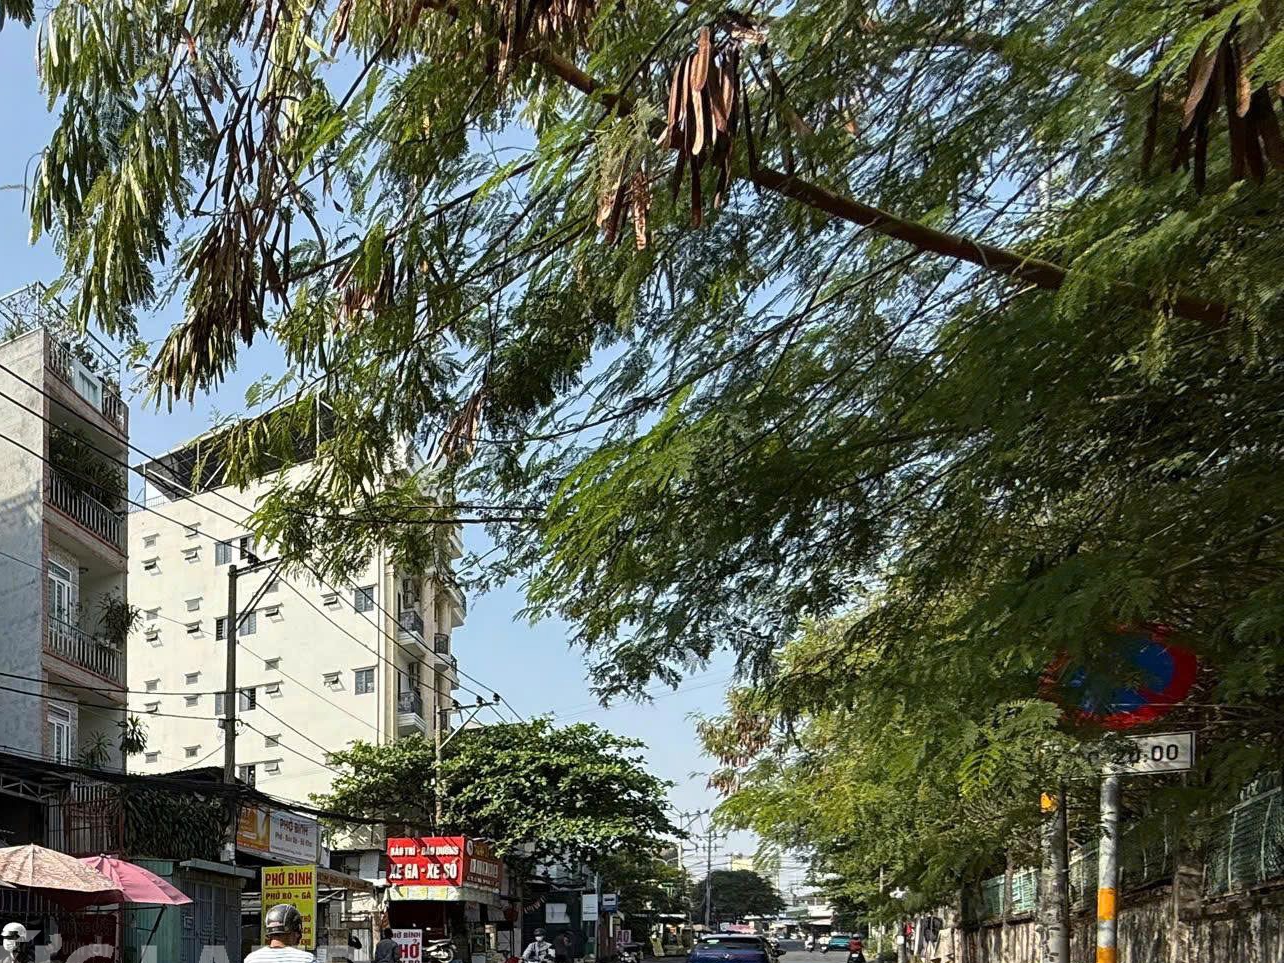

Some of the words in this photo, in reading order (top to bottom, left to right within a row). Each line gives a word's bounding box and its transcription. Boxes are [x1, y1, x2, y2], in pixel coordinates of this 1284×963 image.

[265, 868, 285, 886] PHỞ
[288, 868, 312, 886] BÌNH
[389, 863, 403, 880] XE
[404, 863, 419, 879] GA
[426, 863, 441, 879] XE
[442, 857, 460, 879] SỐ
[398, 938, 421, 959] HỞ
